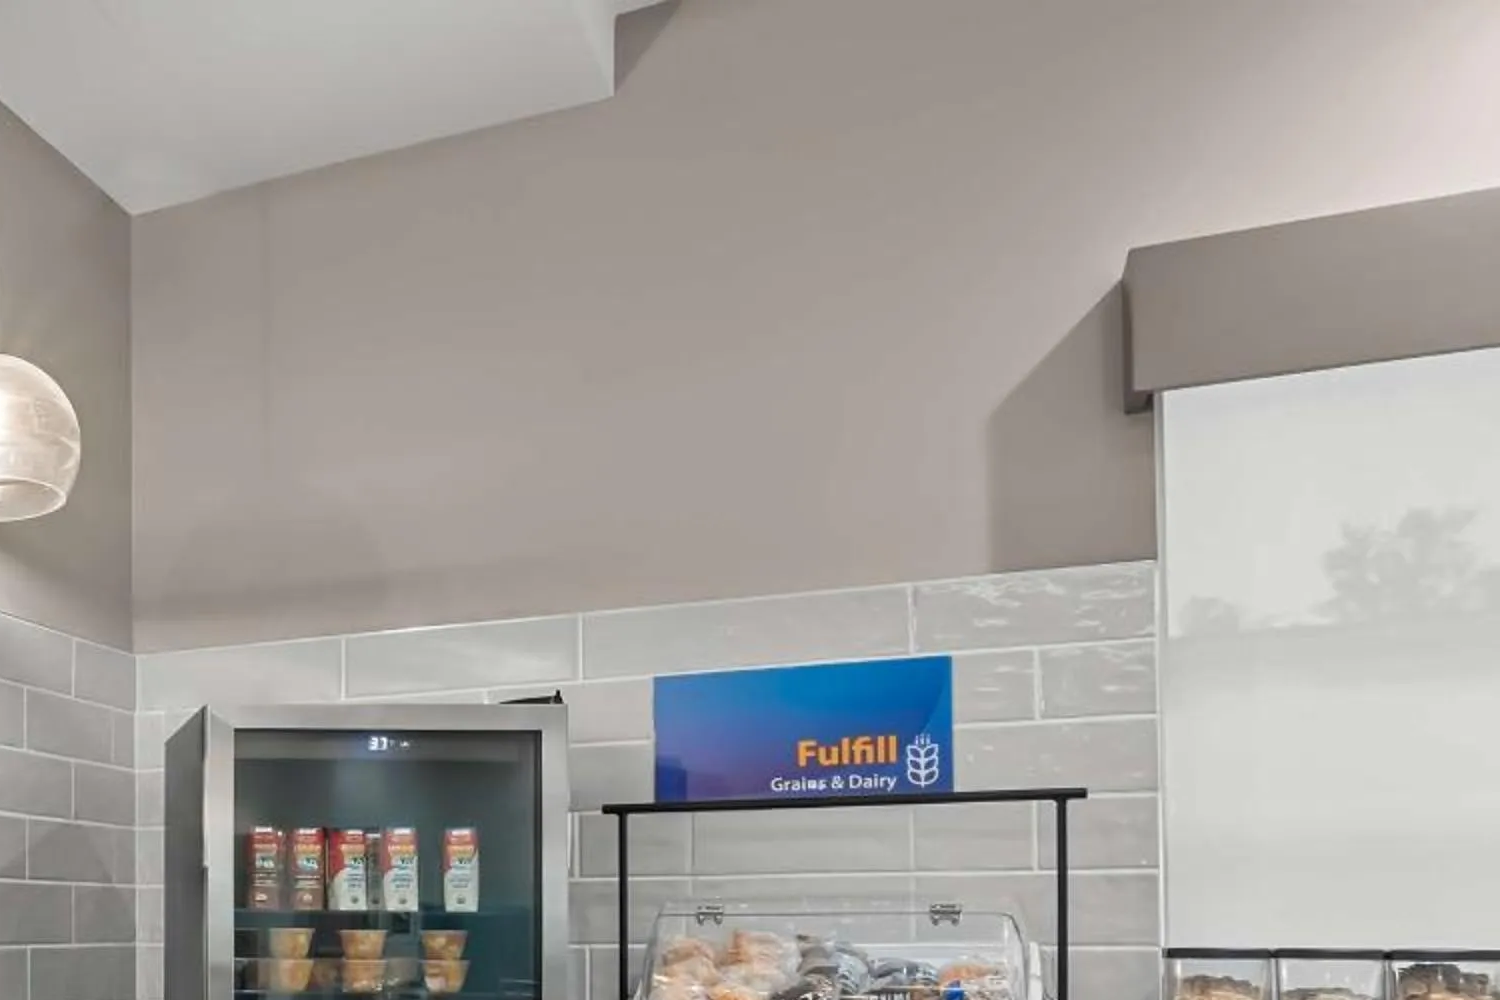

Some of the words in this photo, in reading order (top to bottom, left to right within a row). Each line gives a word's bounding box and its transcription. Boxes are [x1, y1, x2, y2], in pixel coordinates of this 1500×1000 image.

[797, 735, 898, 767] Fulfill
[770, 777, 827, 792] Grains
[831, 775, 844, 789] &
[849, 774, 897, 791] Dairy
